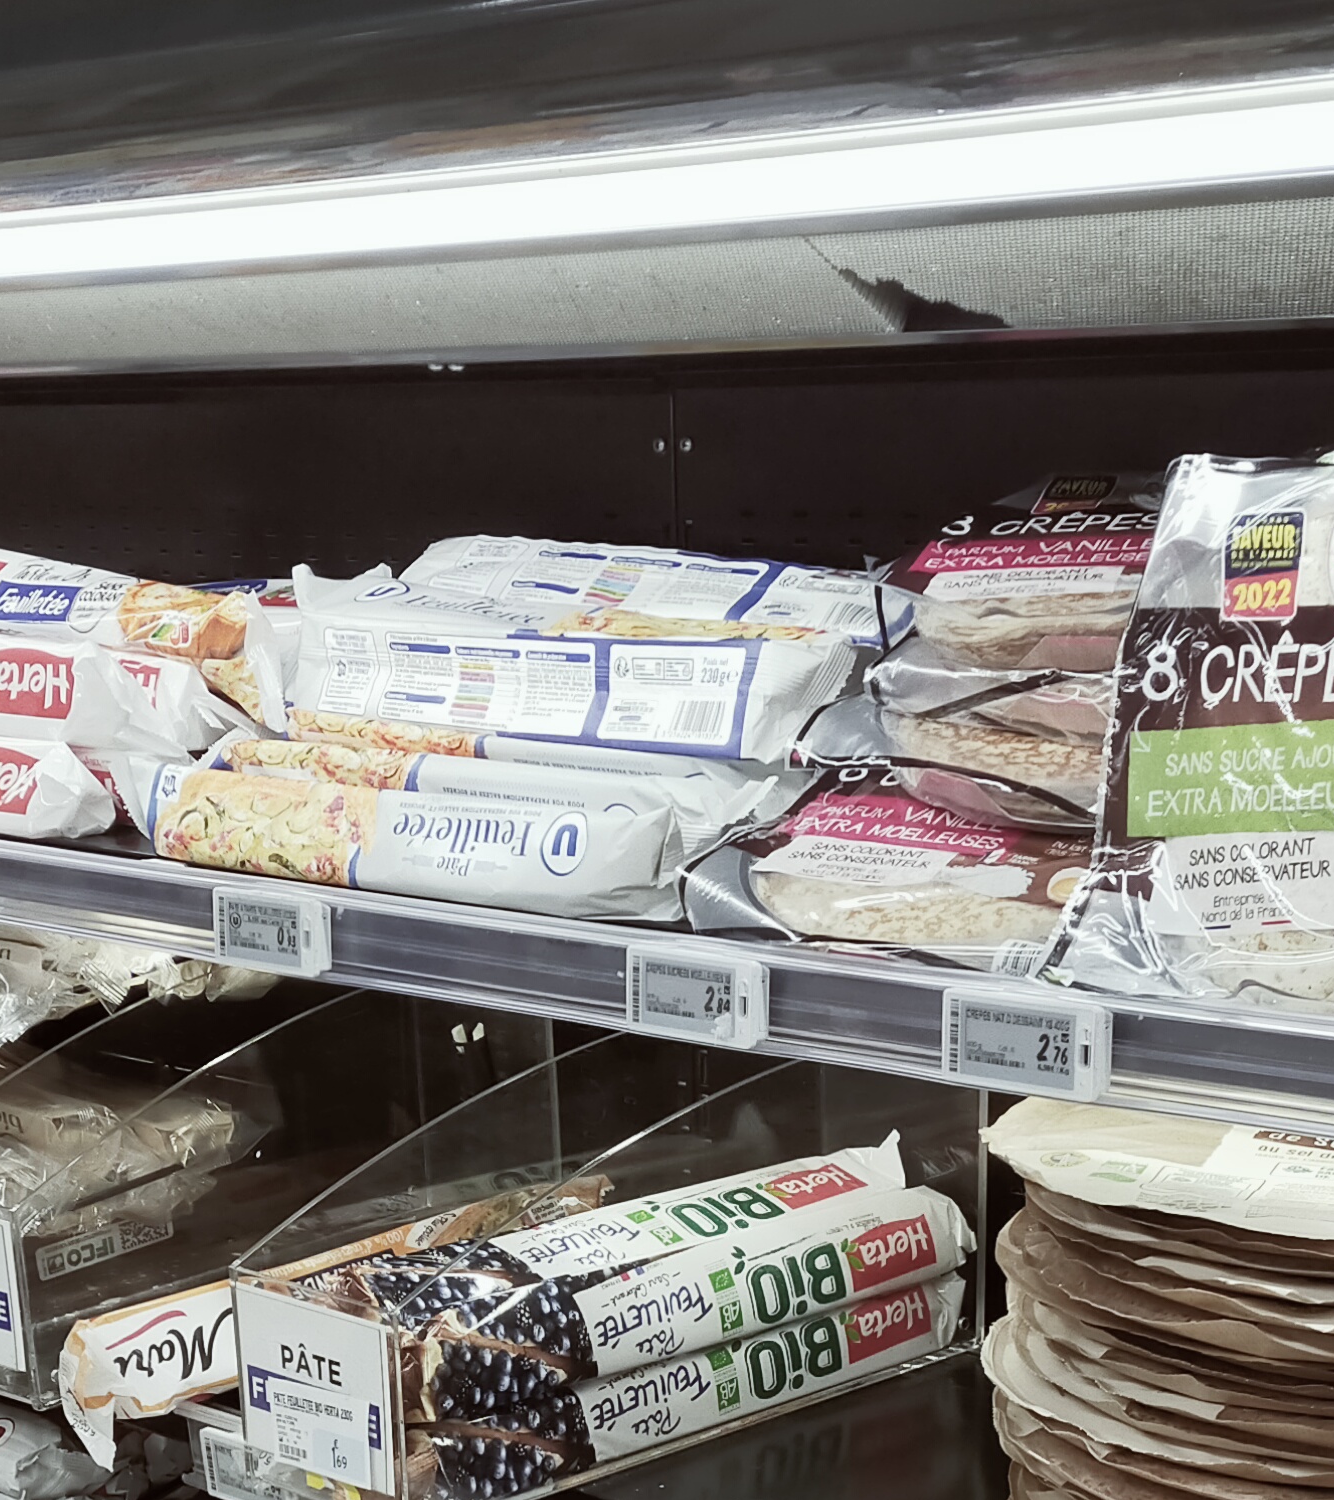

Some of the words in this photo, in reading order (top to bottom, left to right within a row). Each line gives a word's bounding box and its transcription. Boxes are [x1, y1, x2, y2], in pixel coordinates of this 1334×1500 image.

[942, 516, 972, 535] 3
[990, 513, 1160, 535] CRÊPES
[1230, 529, 1297, 550] SAVEUR
[1232, 579, 1291, 612] 2022
[1142, 646, 1178, 701] 8
[1166, 750, 1213, 776] SANS
[1221, 744, 1286, 772] SUCRE
[1147, 788, 1222, 819] EXTRA
[393, 813, 535, 858] Feuilletée
[794, 817, 863, 837] EXTRA
[869, 824, 1004, 850] MOELLEUSES
[436, 854, 469, 876] Pâte
[812, 842, 852, 853] SANS
[854, 845, 925, 858] COLORANT
[1189, 845, 1226, 866] SANS
[1231, 838, 1314, 864] COLORANT
[1175, 869, 1213, 891] SANS
[1217, 860, 1331, 888] CONSERVATEUR
[775, 1164, 850, 1198] Herta
[66, 1236, 116, 1266] IFCO
[860, 1223, 929, 1269] Herta
[858, 1289, 927, 1340] Herta
[280, 1343, 343, 1387] PÂTE
